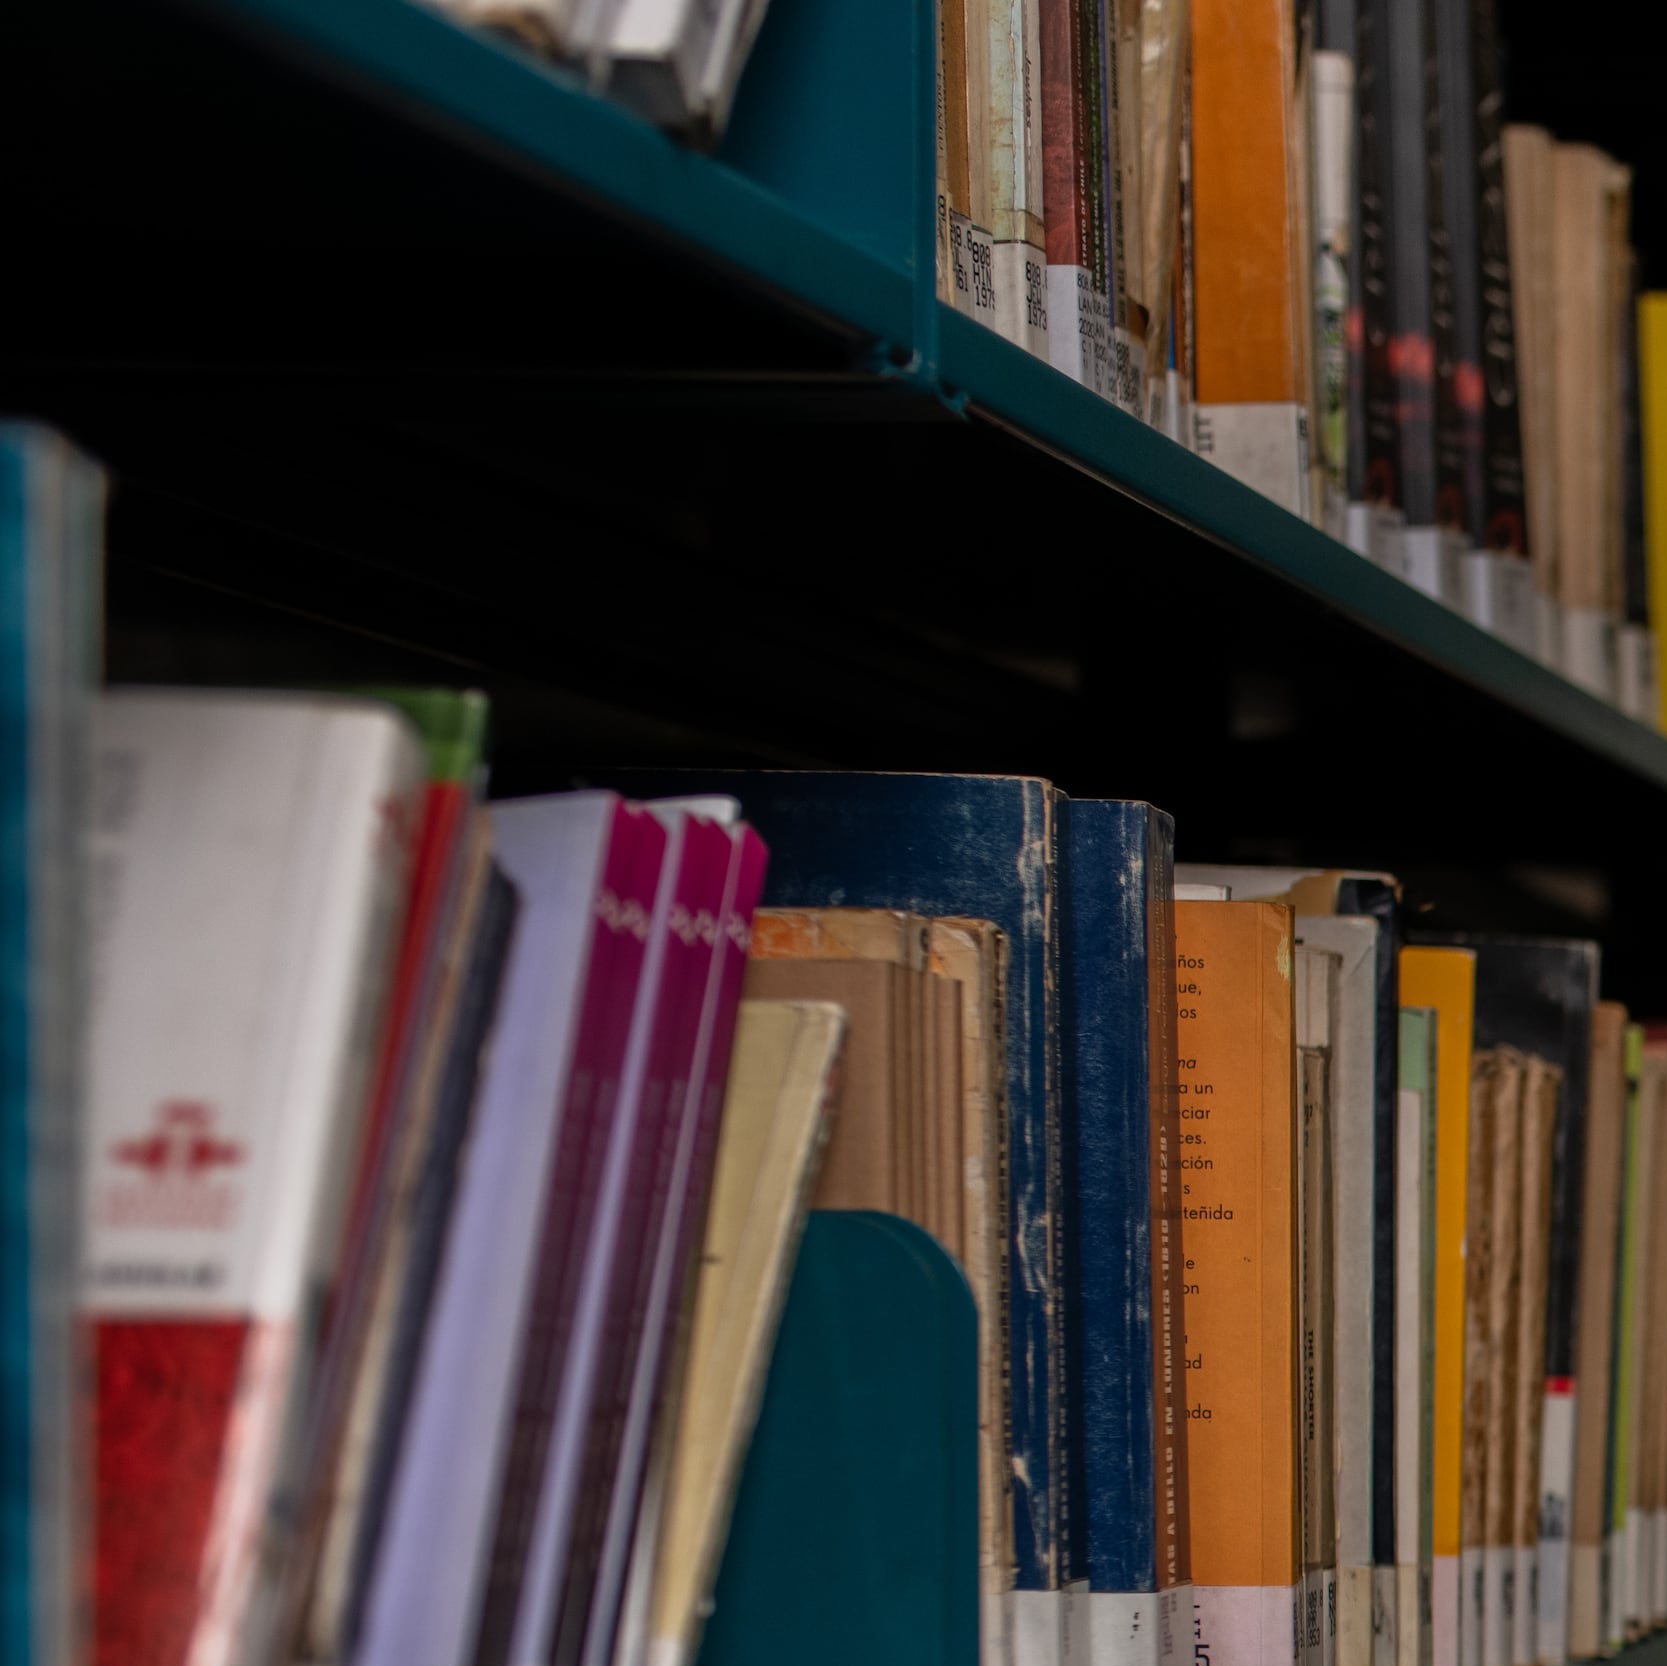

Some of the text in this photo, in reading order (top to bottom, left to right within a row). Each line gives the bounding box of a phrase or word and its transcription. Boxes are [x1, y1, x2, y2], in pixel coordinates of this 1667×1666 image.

[1080, 198, 1086, 215] DE
[1027, 304, 1048, 331] 1973
[1177, 955, 1204, 969] ños
[1178, 983, 1202, 996] ue,
[1178, 1007, 1197, 1020] os
[1195, 1083, 1213, 1095] un
[1180, 1105, 1210, 1120] ciar
[1178, 1133, 1206, 1145] ces.
[1181, 1154, 1213, 1170] ción
[1183, 1203, 1233, 1220] teñida
[1183, 1282, 1199, 1295] on
[1162, 1288, 1173, 1393] LONDRES
[1184, 1354, 1202, 1369] ad
[1184, 1404, 1211, 1420] nda
[1165, 1407, 1173, 1434] EN
[1166, 1448, 1174, 1514] BELLO
[1167, 1545, 1175, 1584] TAS
